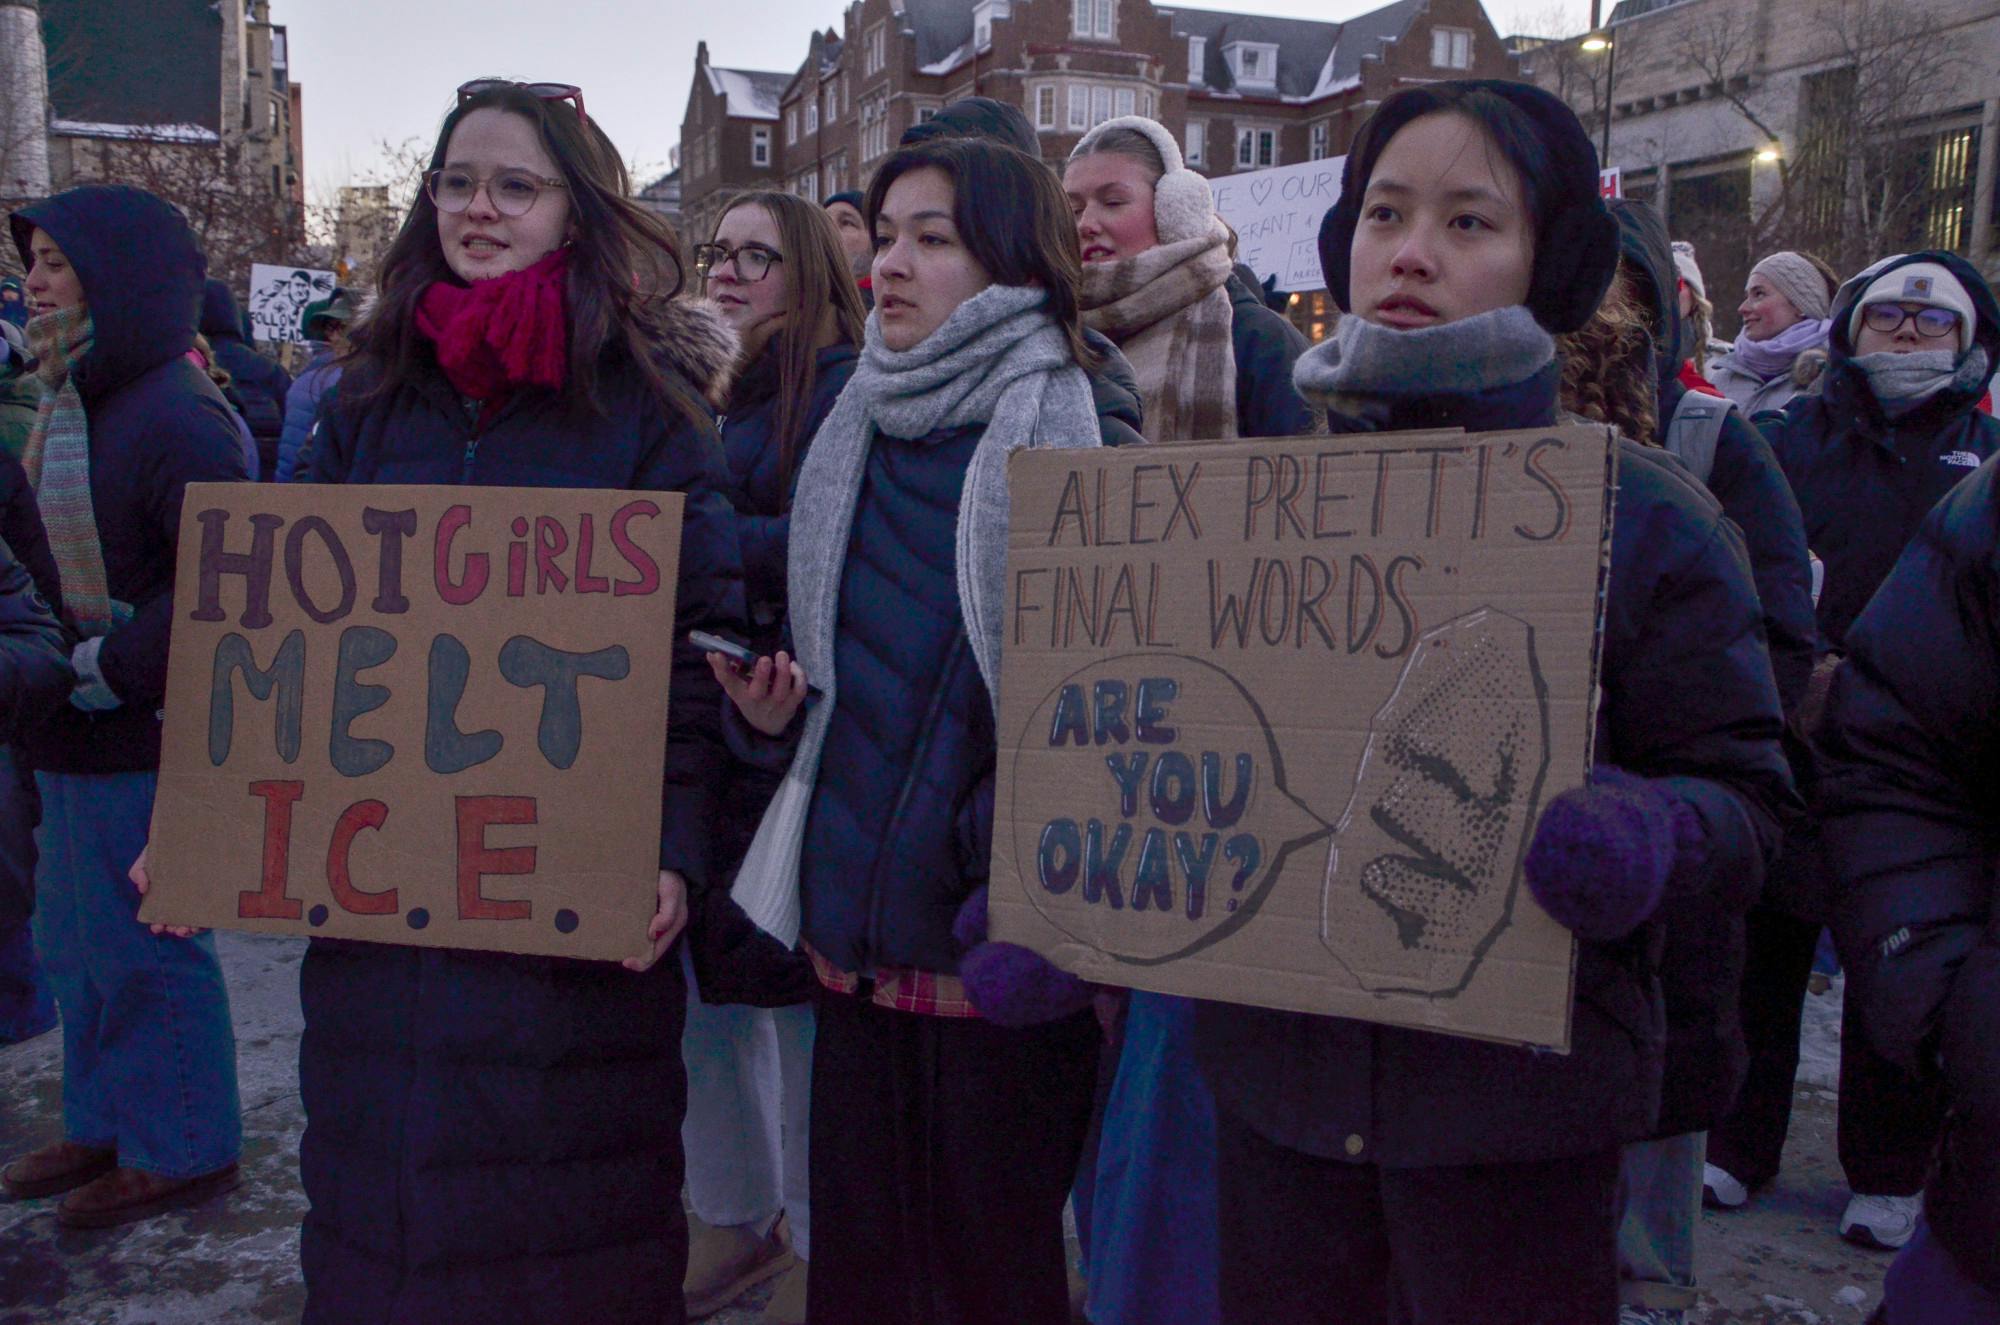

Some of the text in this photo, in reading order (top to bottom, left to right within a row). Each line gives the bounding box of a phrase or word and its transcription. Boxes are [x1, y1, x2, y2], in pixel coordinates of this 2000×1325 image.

[1282, 171, 1333, 201] OUR
[1047, 437, 1572, 547] ALEX PRETTI'S
[190, 506, 417, 629] HOT
[1012, 562, 1176, 649] FINAL
[208, 625, 631, 778] MELT
[1048, 677, 1182, 747] ARE
[1105, 751, 1256, 829] YOU
[237, 779, 580, 934] I.C.E.
[1037, 817, 1262, 922] OKAY?
